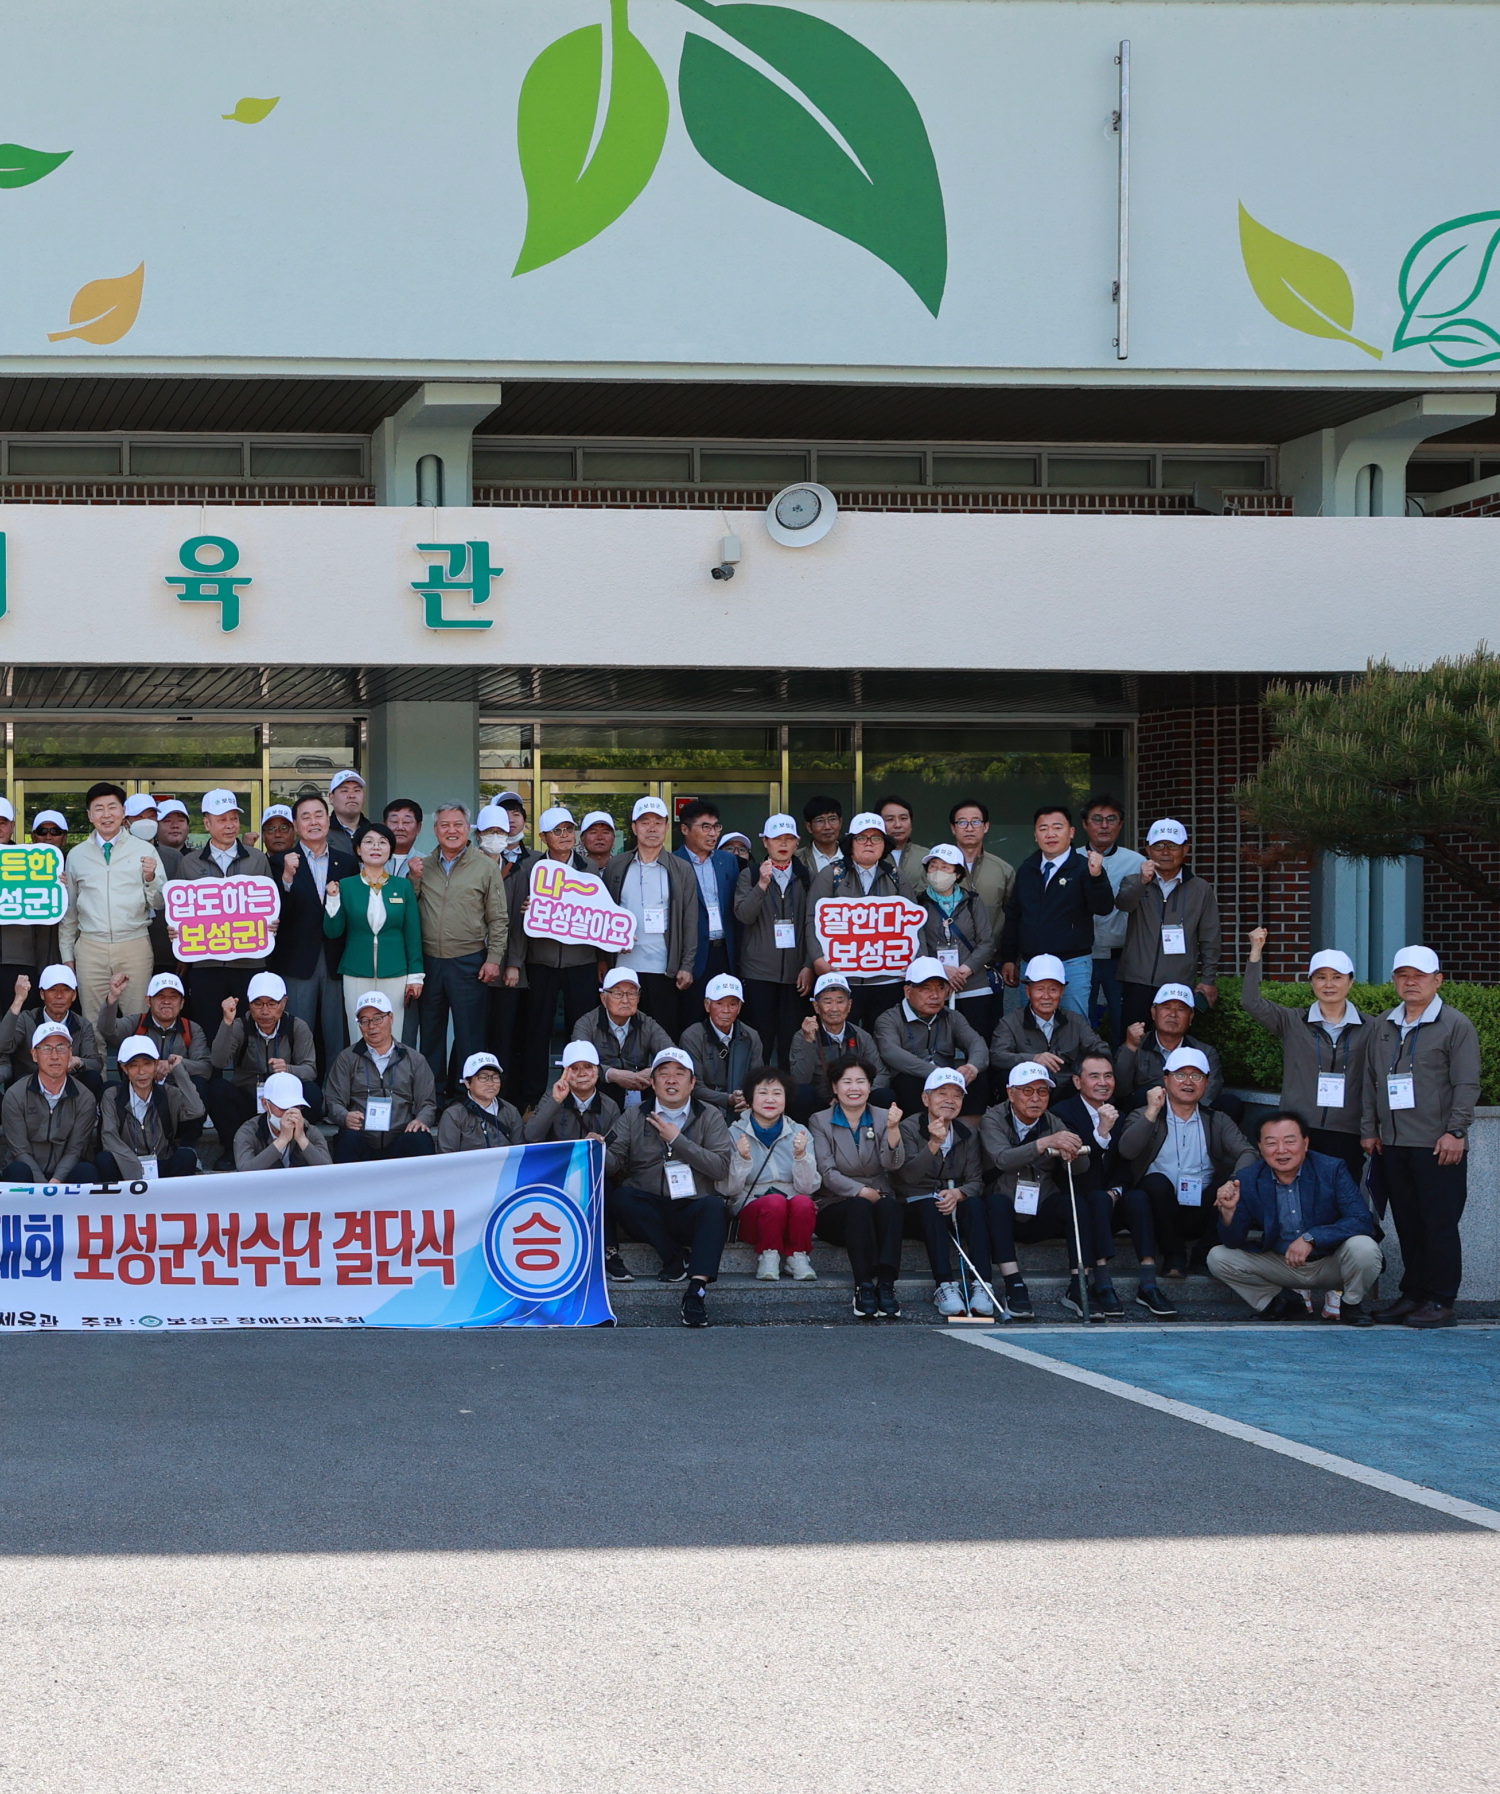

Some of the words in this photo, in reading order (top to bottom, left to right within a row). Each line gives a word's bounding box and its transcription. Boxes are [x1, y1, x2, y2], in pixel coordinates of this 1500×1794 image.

[1159, 827, 1179, 835] 보성군
[169, 884, 274, 919] 압도하는
[181, 919, 266, 953] 보성군!
[528, 899, 631, 944] 보성살아요
[830, 938, 911, 969] 보성군
[363, 997, 382, 1005] 보성군
[1169, 989, 1189, 999] 보성군
[74, 1209, 322, 1287] 보성군선수단
[332, 1208, 456, 1286] 결단식
[511, 1211, 563, 1272] 승
[81, 1316, 123, 1327] 주관
[166, 1316, 231, 1326] 보성군
